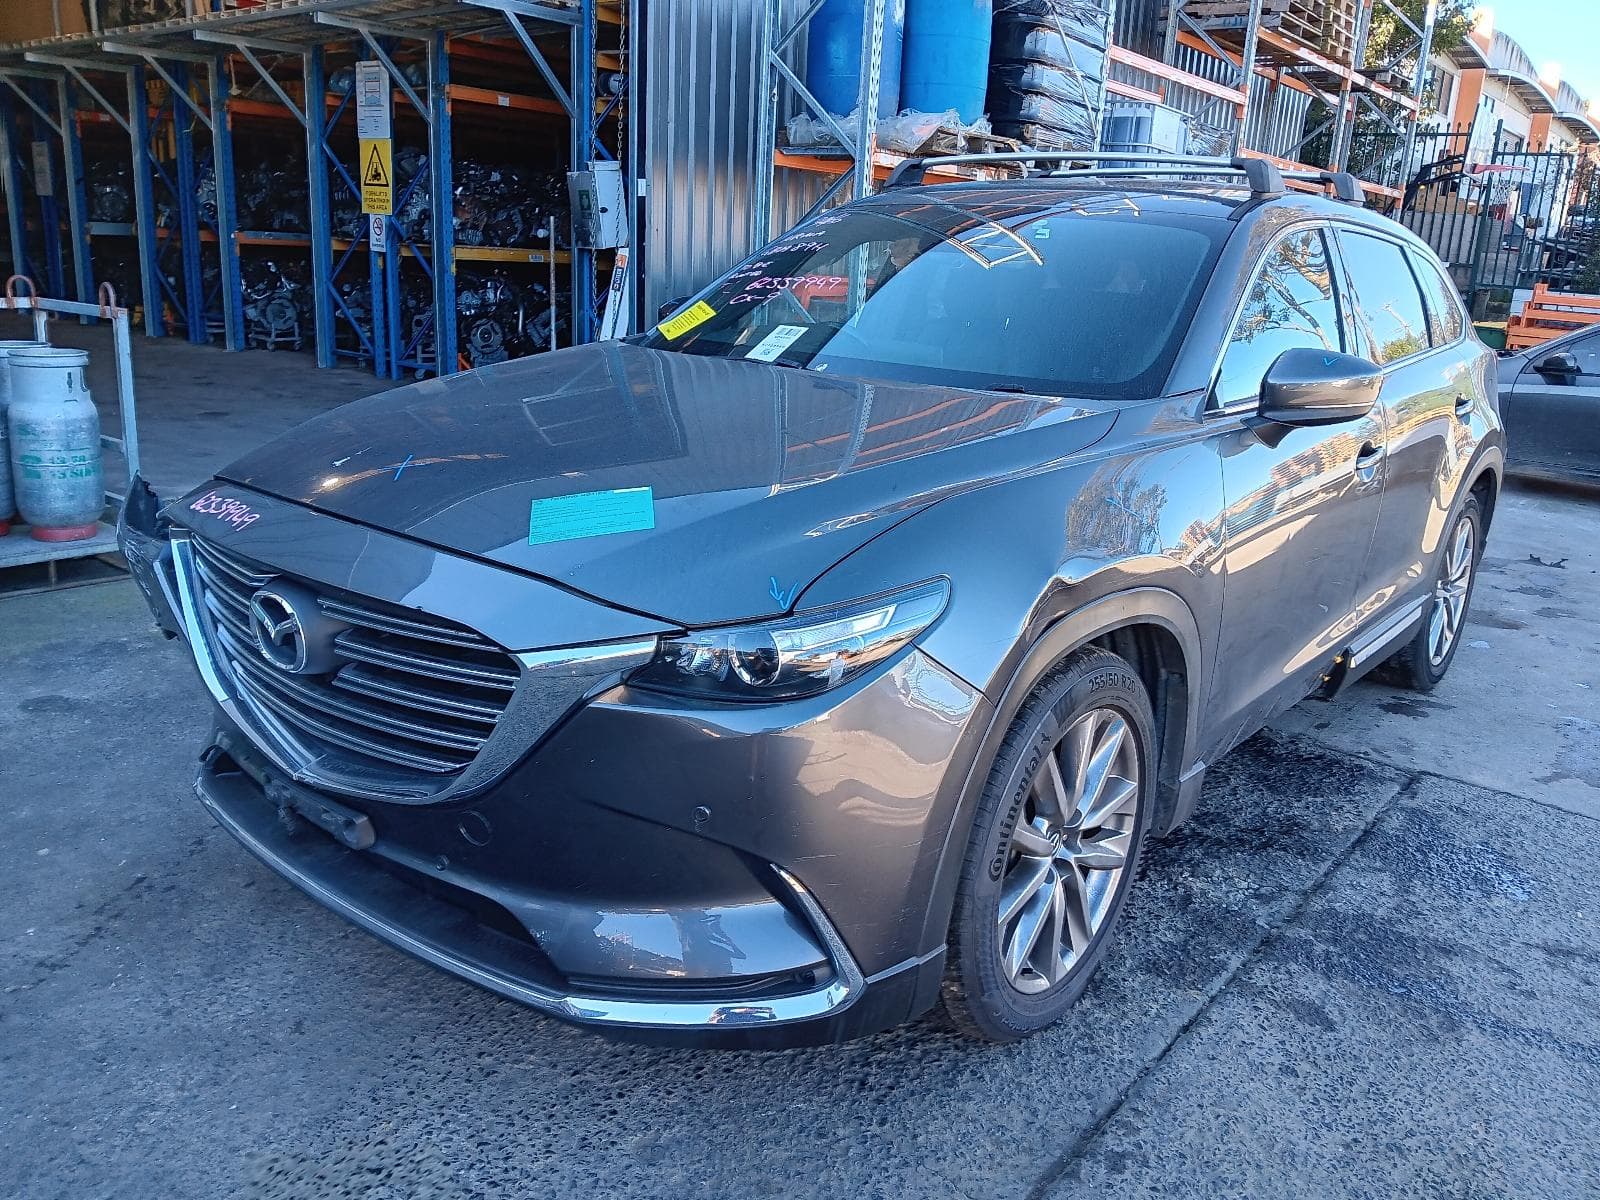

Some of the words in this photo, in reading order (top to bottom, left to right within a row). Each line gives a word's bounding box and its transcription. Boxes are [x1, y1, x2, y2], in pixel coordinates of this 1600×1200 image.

[1088, 671, 1119, 694] 255/50
[1121, 673, 1136, 694] R20
[988, 744, 1043, 882] Continental
